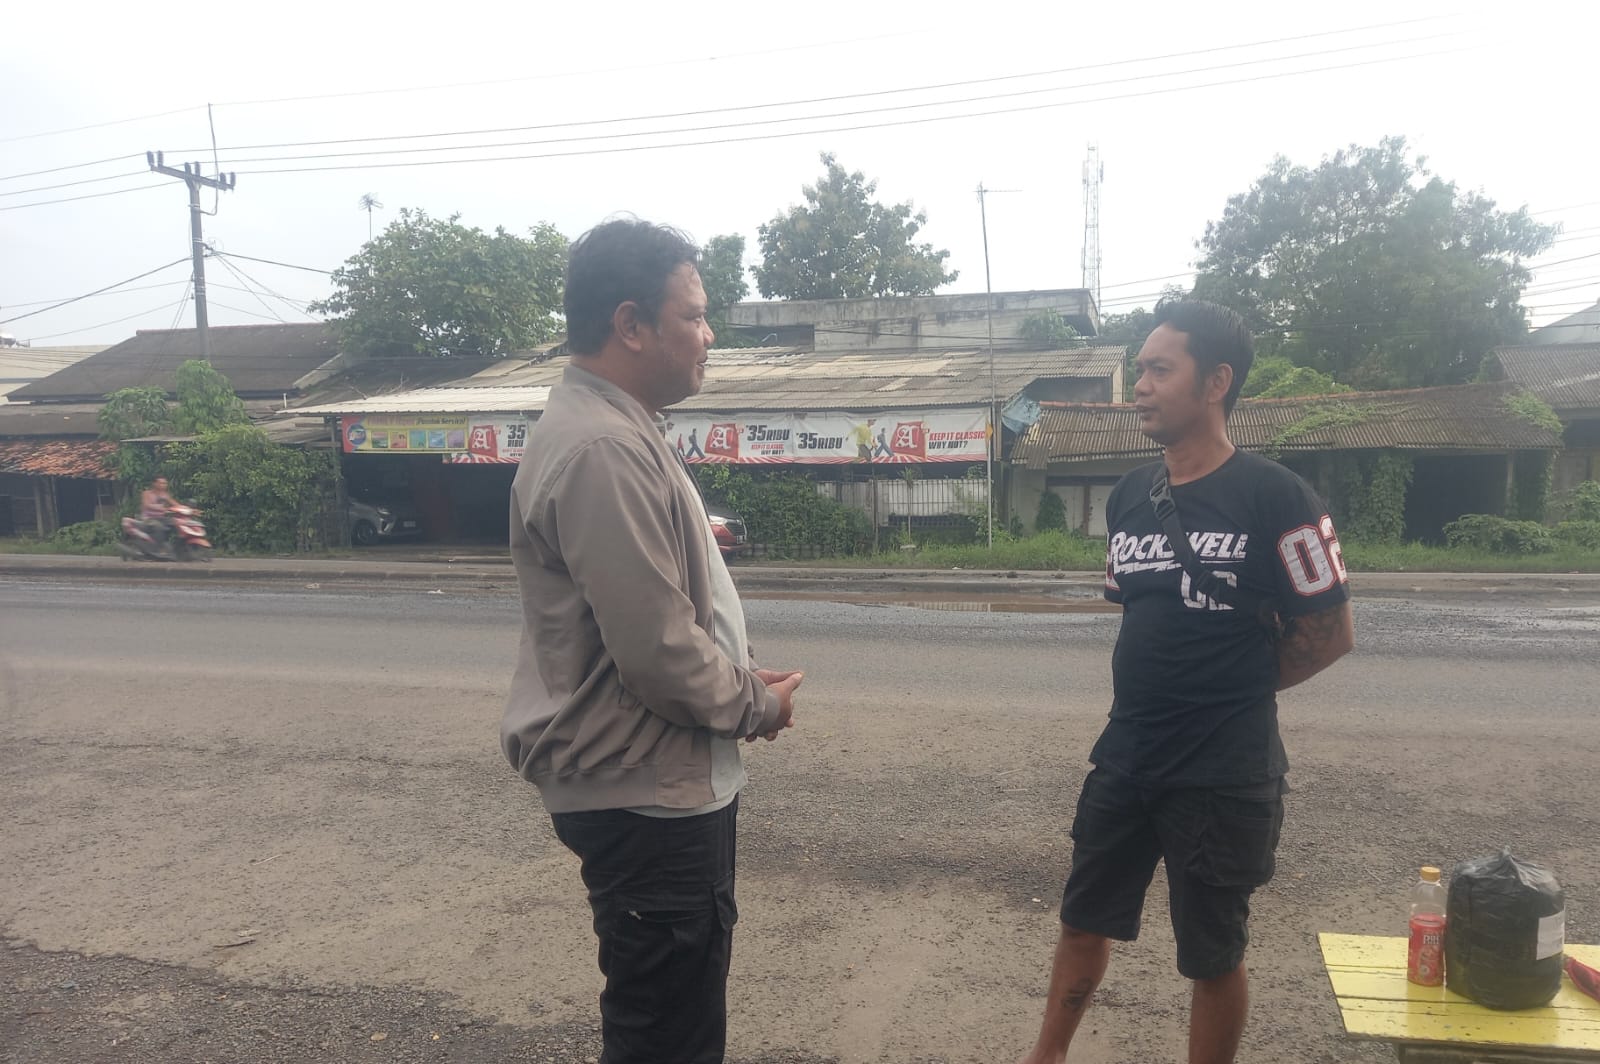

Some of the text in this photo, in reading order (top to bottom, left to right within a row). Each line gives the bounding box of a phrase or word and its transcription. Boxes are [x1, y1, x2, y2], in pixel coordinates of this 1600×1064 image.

[928, 430, 986, 441] KEEP IT CLASSIC
[817, 436, 843, 449] RIBU
[928, 440, 969, 449] WHY NOT?
